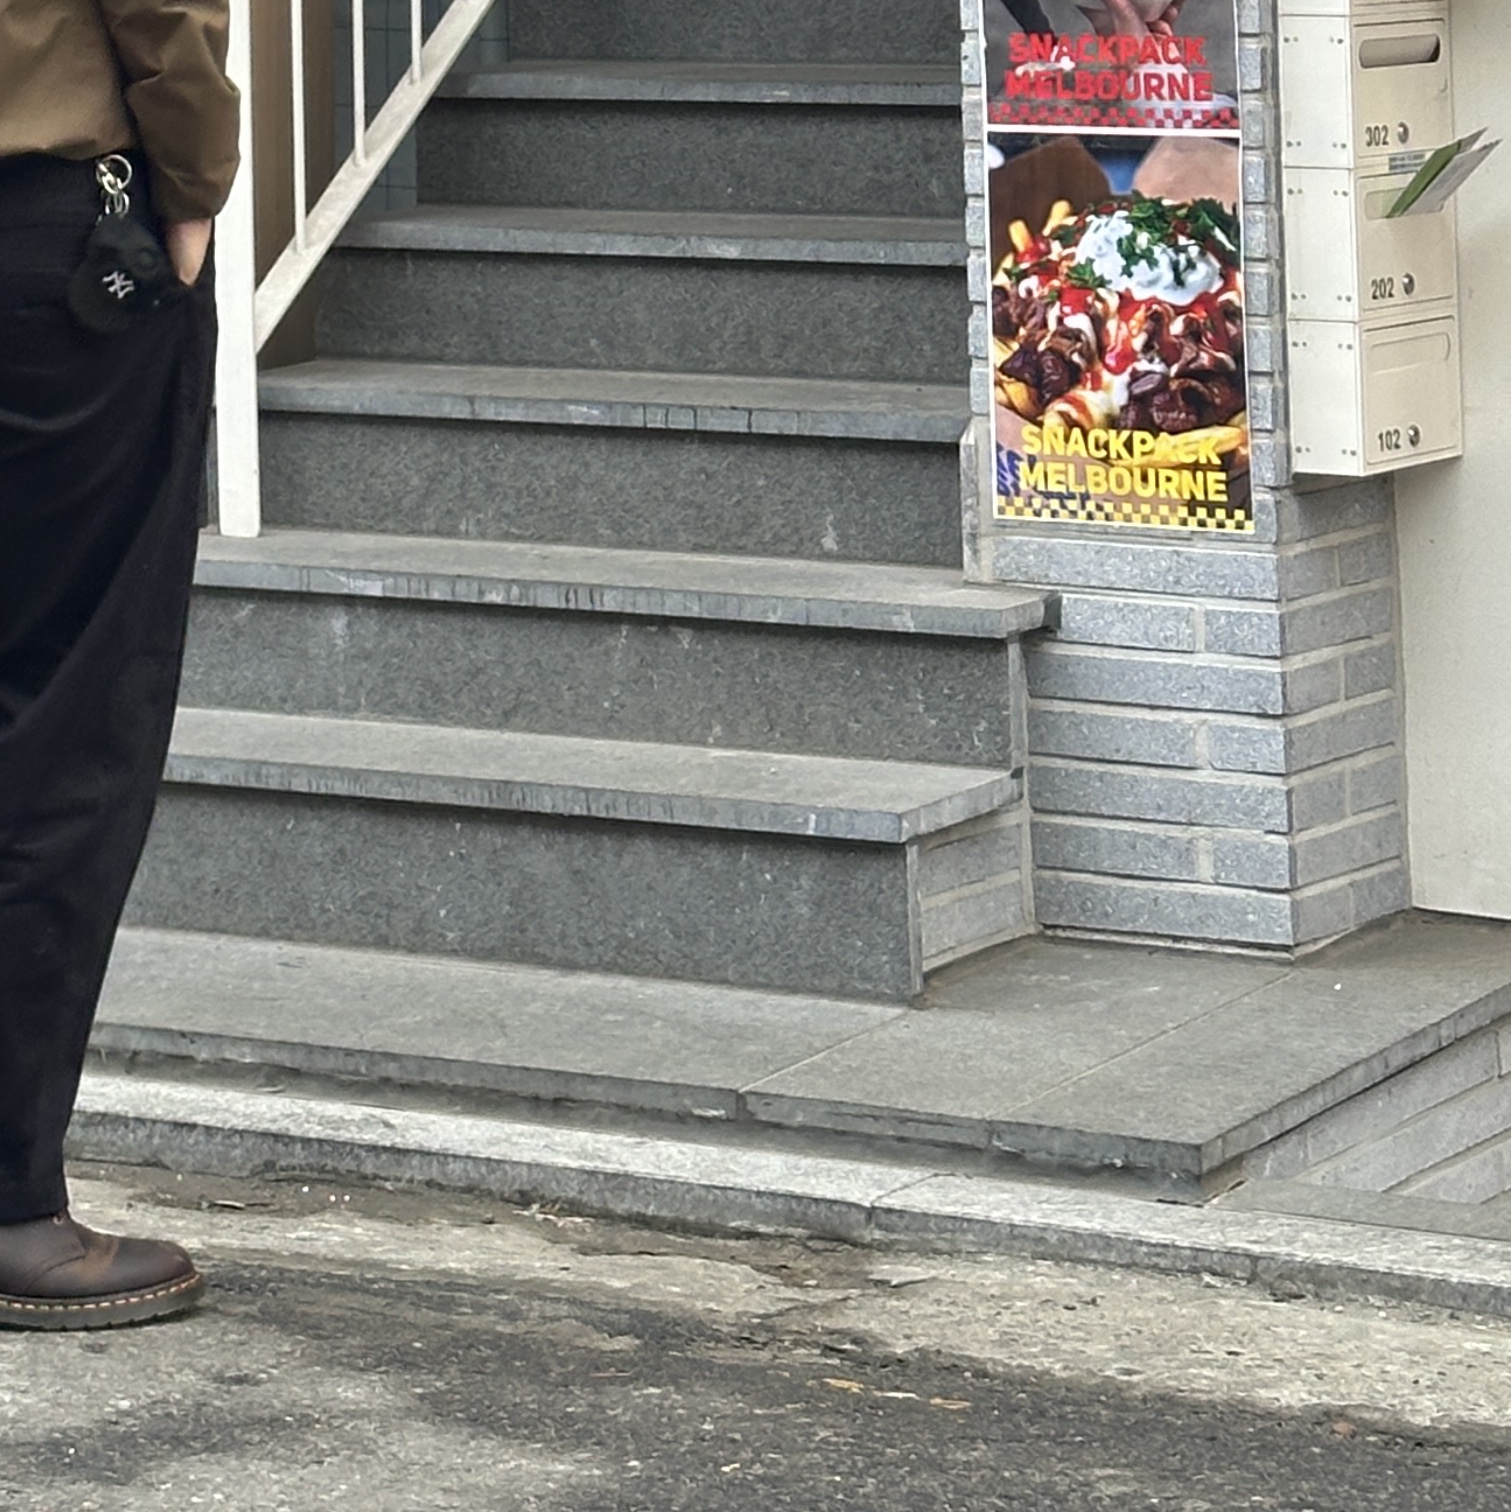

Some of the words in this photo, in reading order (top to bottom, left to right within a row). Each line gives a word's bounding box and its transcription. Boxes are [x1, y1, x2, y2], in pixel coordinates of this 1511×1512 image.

[1008, 34, 1206, 66] SNACKPACK
[1004, 69, 1214, 102] MELBOURNE
[1365, 124, 1389, 147] 302
[1371, 276, 1395, 300] 202
[1020, 426, 1221, 466] SNACKPACK
[1378, 428, 1401, 453] 102
[1018, 462, 1229, 503] MELBOURNE
